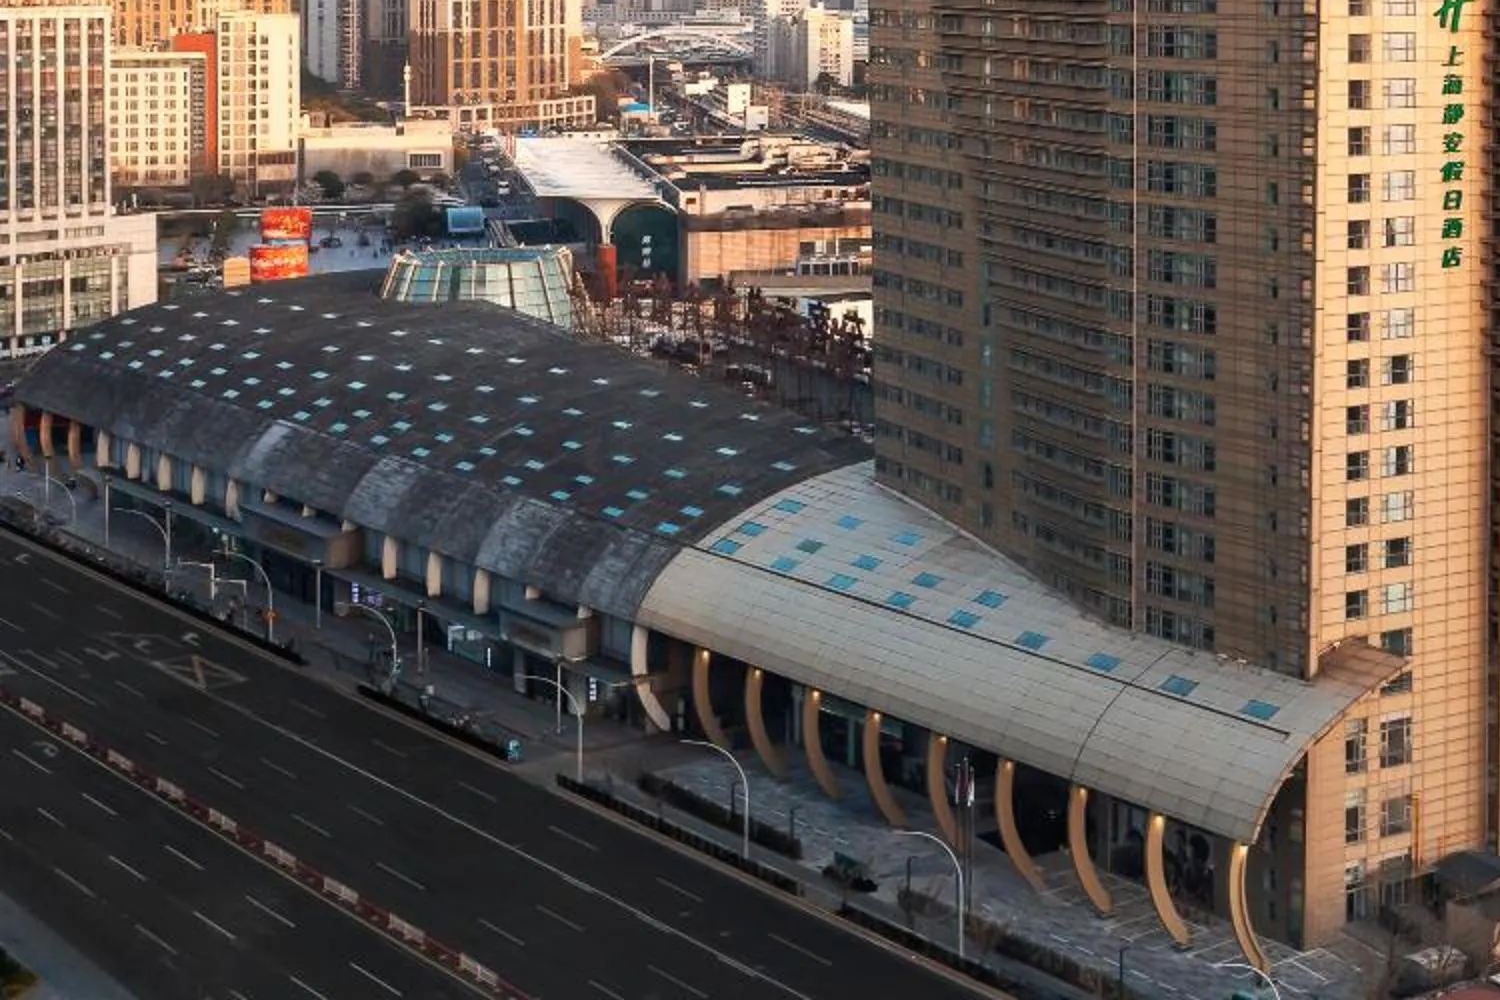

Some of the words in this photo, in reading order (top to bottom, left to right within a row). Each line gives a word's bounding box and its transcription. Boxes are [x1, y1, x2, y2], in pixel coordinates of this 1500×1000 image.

[1440, 46, 1465, 268] 上海静安假日酒店
